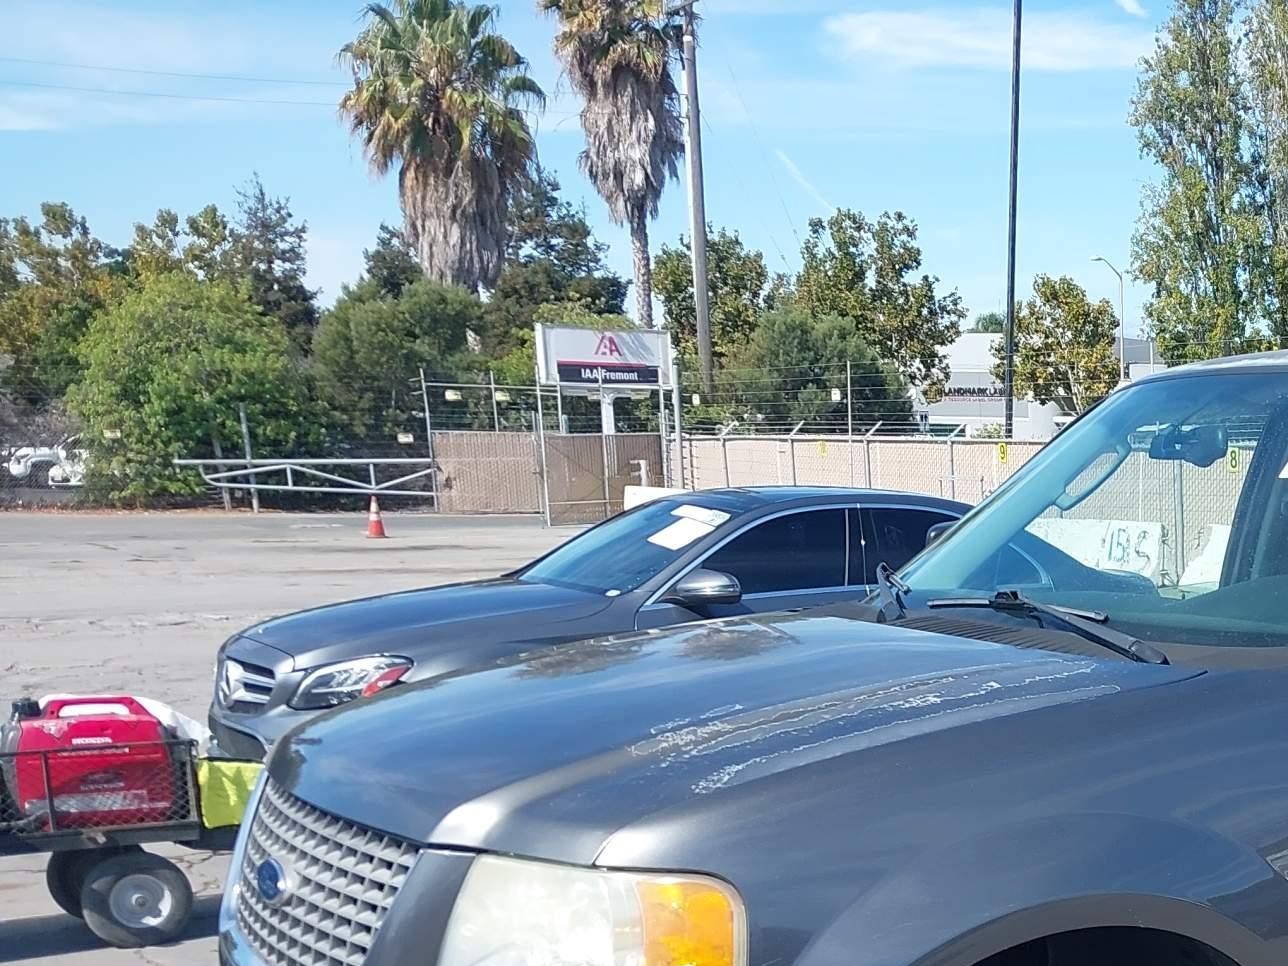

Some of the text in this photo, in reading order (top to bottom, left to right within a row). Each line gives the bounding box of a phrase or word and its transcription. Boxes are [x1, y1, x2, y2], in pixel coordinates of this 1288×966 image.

[581, 368, 638, 381] IAA Fremont
[944, 387, 988, 396] LANDMARK
[999, 444, 1005, 459] 9
[1230, 451, 1237, 469] 8
[72, 737, 112, 745] HONDA
